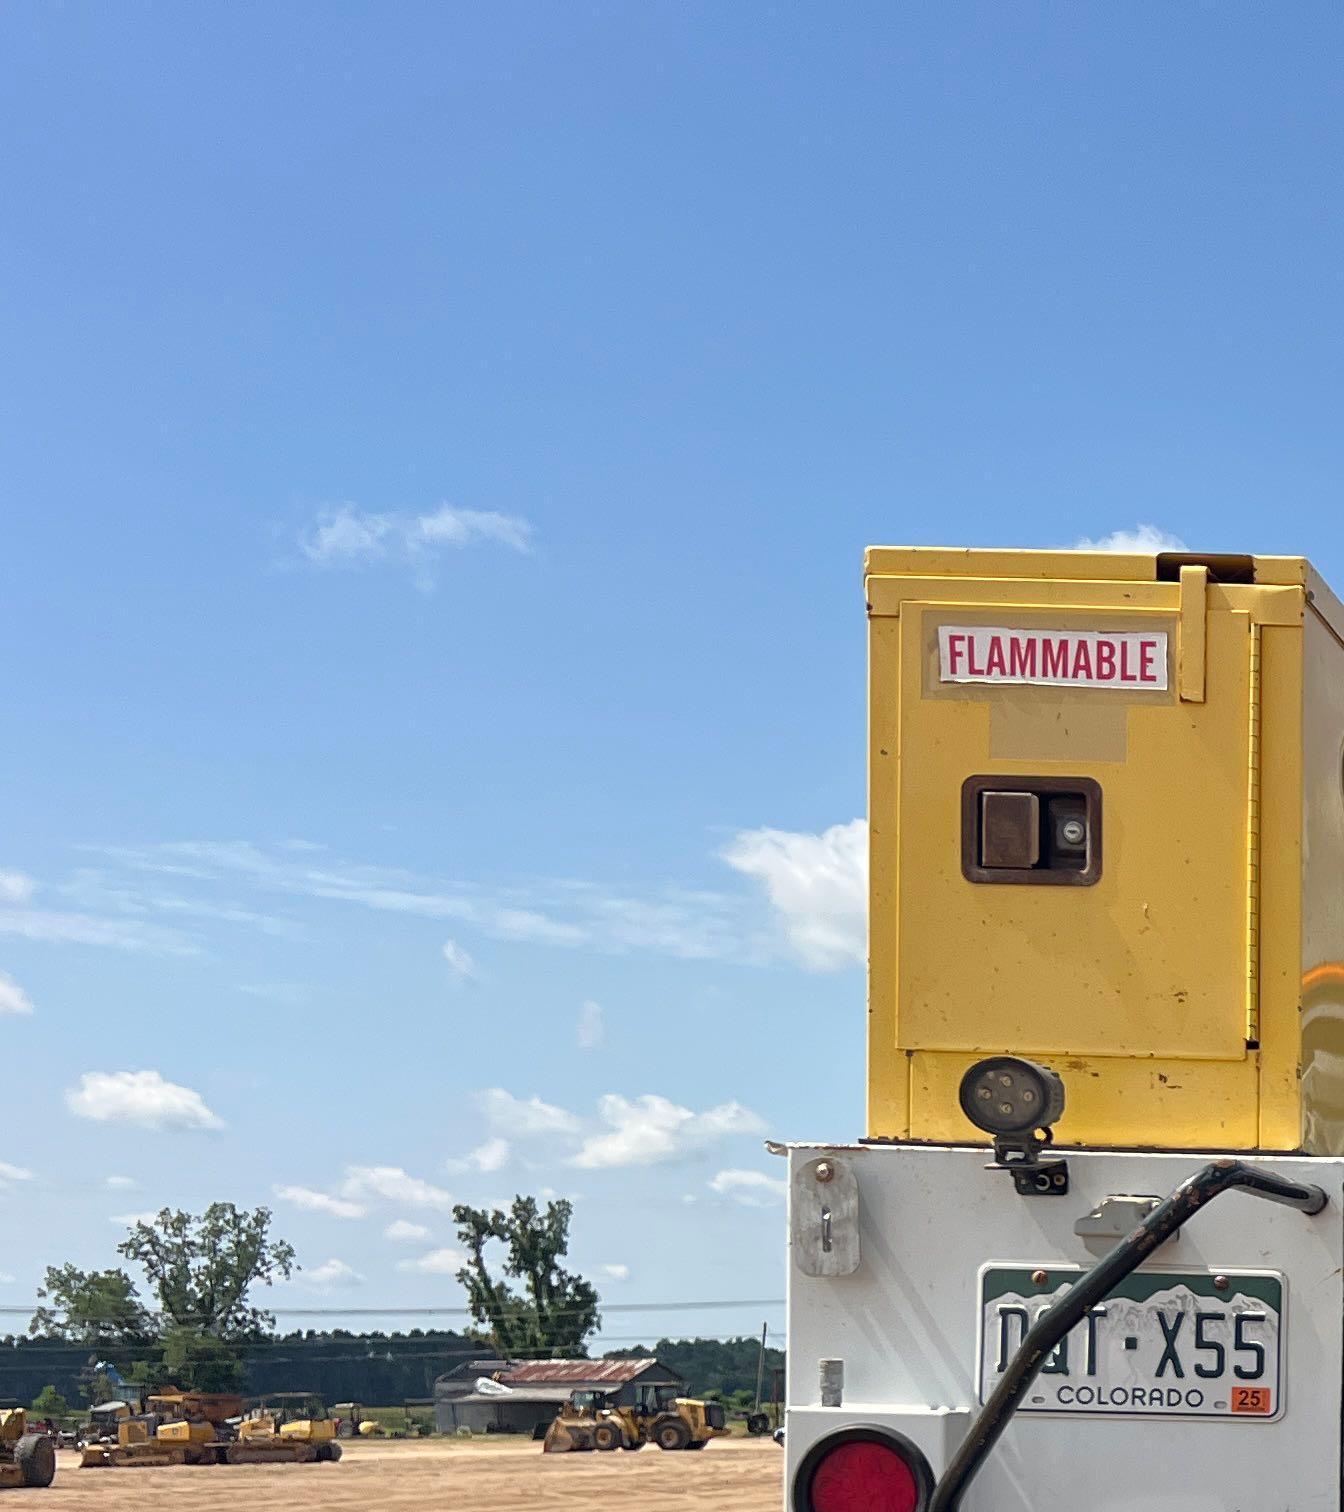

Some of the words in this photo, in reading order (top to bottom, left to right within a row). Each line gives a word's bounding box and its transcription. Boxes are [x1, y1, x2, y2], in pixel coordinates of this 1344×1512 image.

[948, 634, 1158, 682] FLAMMABLE
[1056, 1385, 1205, 1408] COLORADO
[1237, 1390, 1261, 1407] 25
